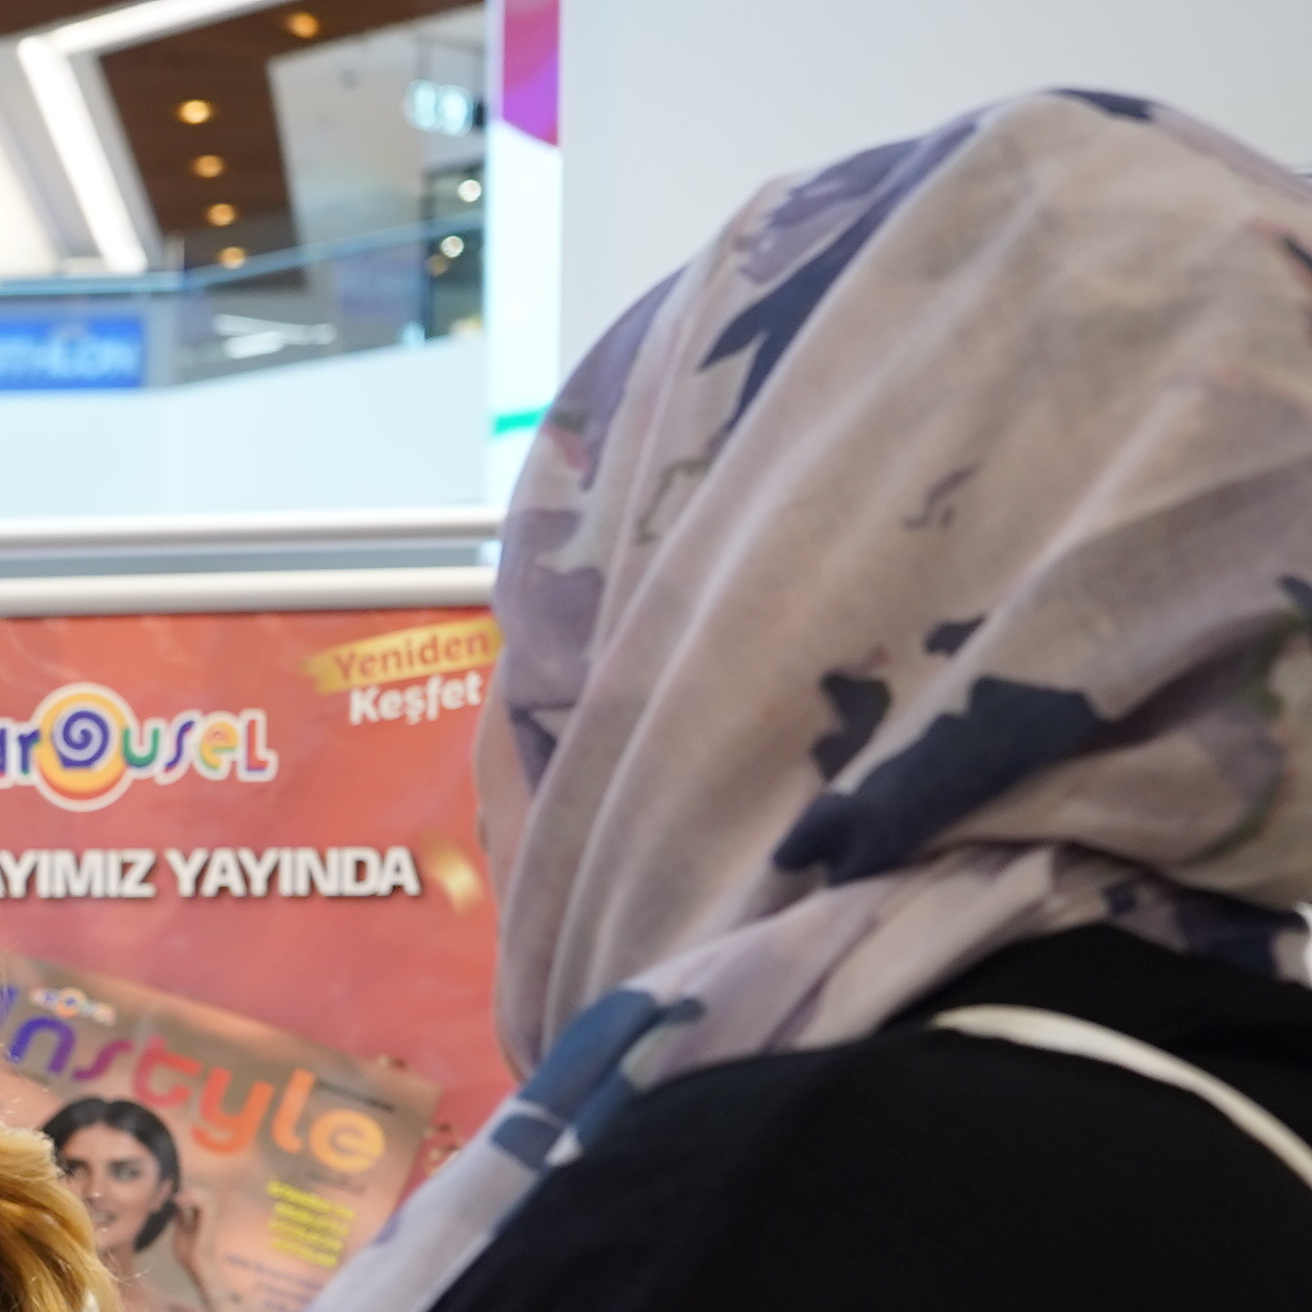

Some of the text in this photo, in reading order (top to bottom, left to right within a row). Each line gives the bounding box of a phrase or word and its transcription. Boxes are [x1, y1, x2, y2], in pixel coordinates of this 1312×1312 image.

[333, 631, 490, 683] Yeniden
[349, 671, 483, 725] Keşfet
[166, 846, 420, 899] YAYINDA
